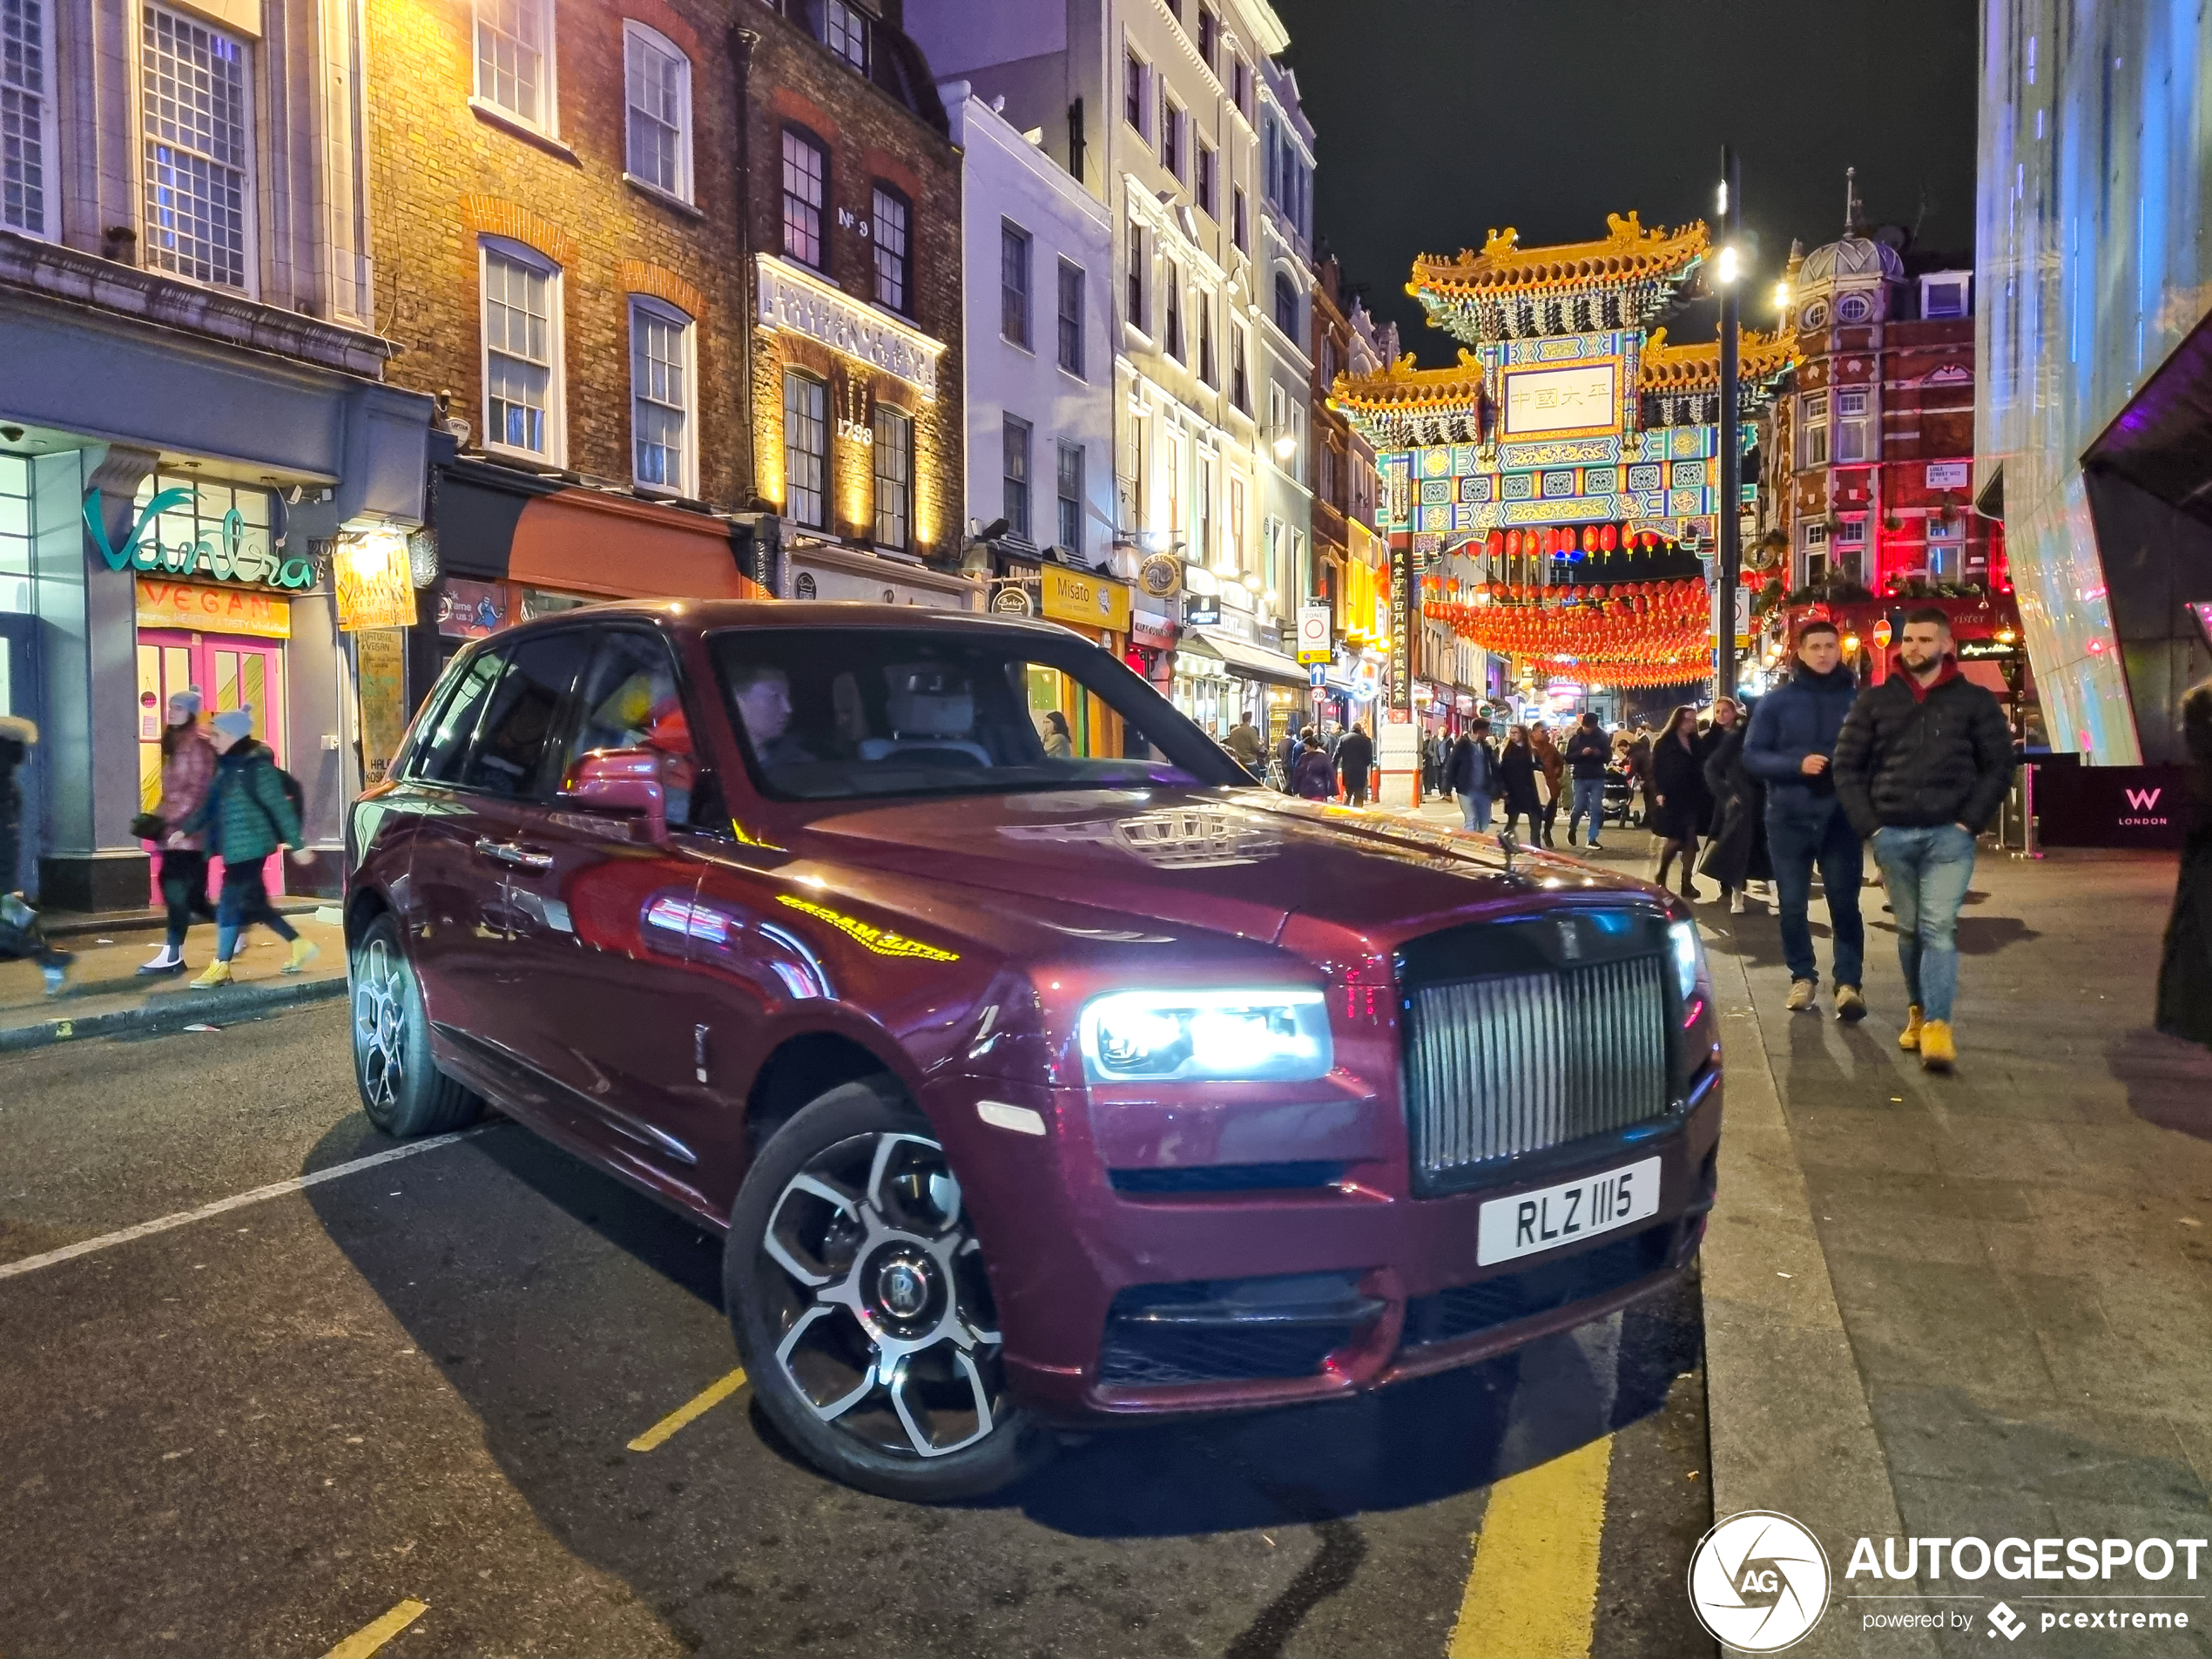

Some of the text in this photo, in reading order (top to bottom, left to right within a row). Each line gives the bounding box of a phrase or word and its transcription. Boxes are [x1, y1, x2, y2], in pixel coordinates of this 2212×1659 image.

[859, 220, 868, 237] 9
[837, 417, 873, 447] 1798
[143, 581, 271, 617] VEGAN
[1057, 577, 1090, 602] Misato
[2126, 788, 2161, 810] W
[1516, 1188, 1581, 1248] RLZ
